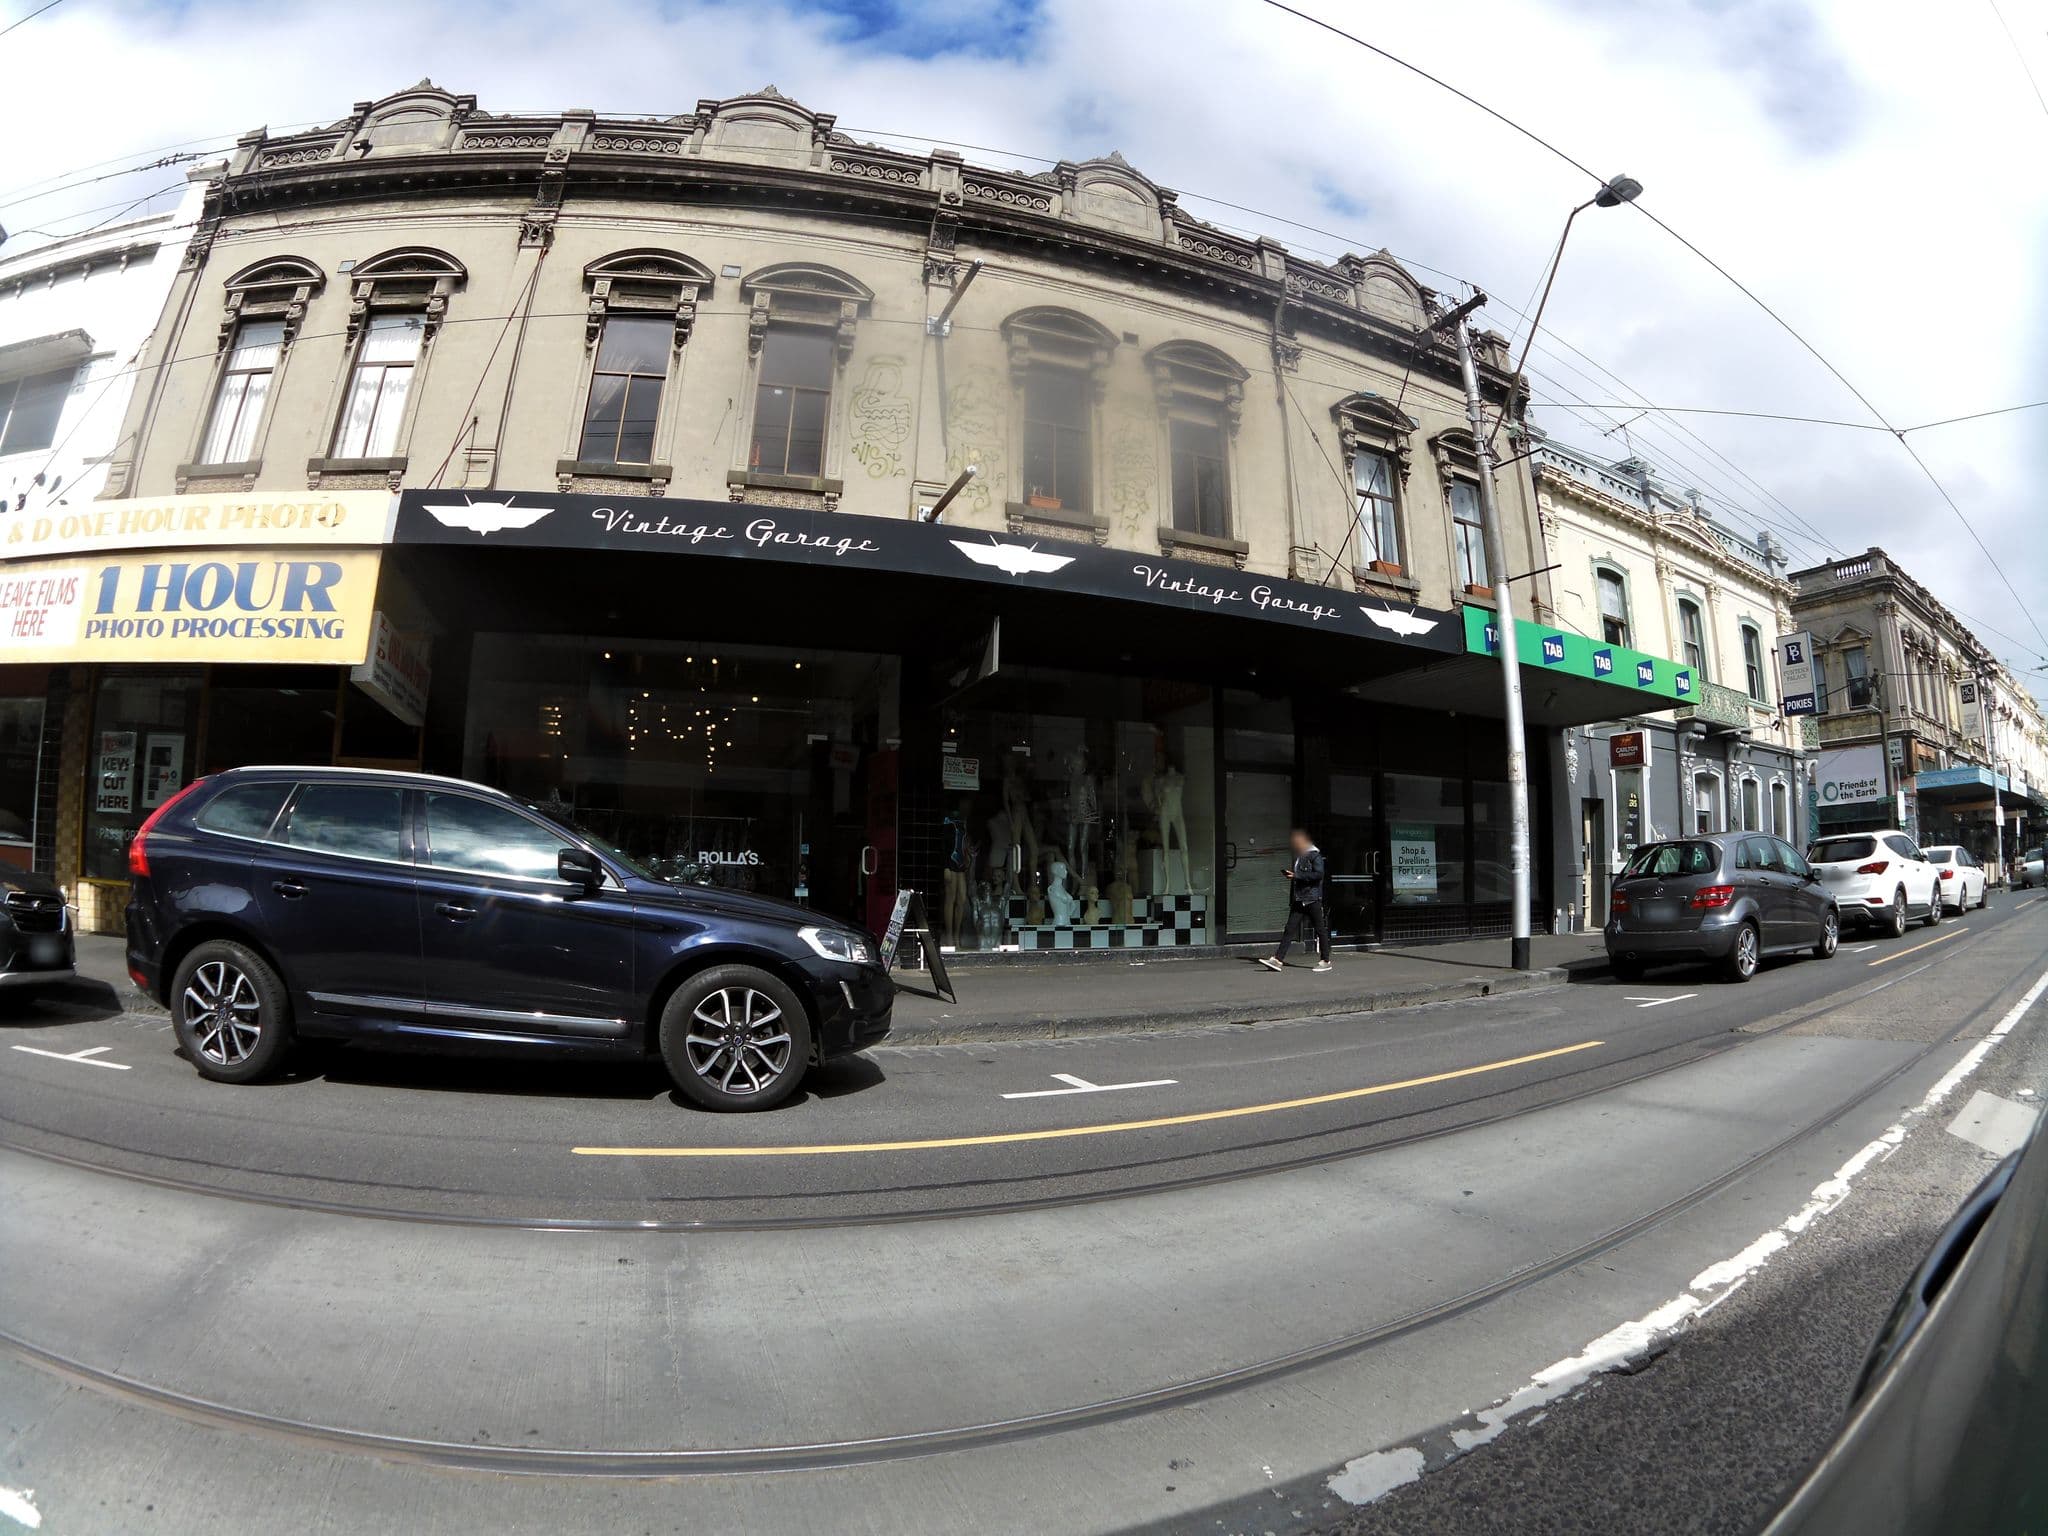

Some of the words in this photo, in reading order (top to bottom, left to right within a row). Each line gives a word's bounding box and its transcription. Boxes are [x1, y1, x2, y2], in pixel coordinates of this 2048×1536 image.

[7, 520, 24, 544] &
[32, 518, 53, 542] D
[59, 511, 113, 540] ONE
[117, 506, 211, 535] HOUR
[219, 502, 347, 530] PHOTO
[591, 508, 735, 544] Vintage
[745, 518, 880, 556] Garage
[36, 577, 79, 607] FILMS
[94, 566, 122, 615] 1
[135, 561, 343, 613] HOUR
[1133, 565, 1244, 604] Vintage
[1250, 585, 1342, 621] Garage
[11, 609, 48, 638] HERE
[85, 618, 165, 639] PHOTO
[171, 618, 345, 640] PROCESSING
[1486, 627, 1499, 643] TA
[1543, 641, 1563, 658] TAB
[1594, 655, 1612, 671] TAB
[1638, 666, 1653, 681] TAB
[1676, 676, 1690, 691] TAB
[1786, 697, 1813, 711] POKIES
[102, 757, 130, 771] KEYS
[103, 776, 126, 790] CUT
[1839, 779, 1868, 790] Friends
[1869, 778, 1877, 786] of
[97, 795, 129, 809] HERE
[1840, 791, 1854, 800] the
[1856, 788, 1877, 797] Earth
[1401, 846, 1419, 856] Shop
[1419, 847, 1426, 855] &
[1411, 866, 1431, 875] Lease
